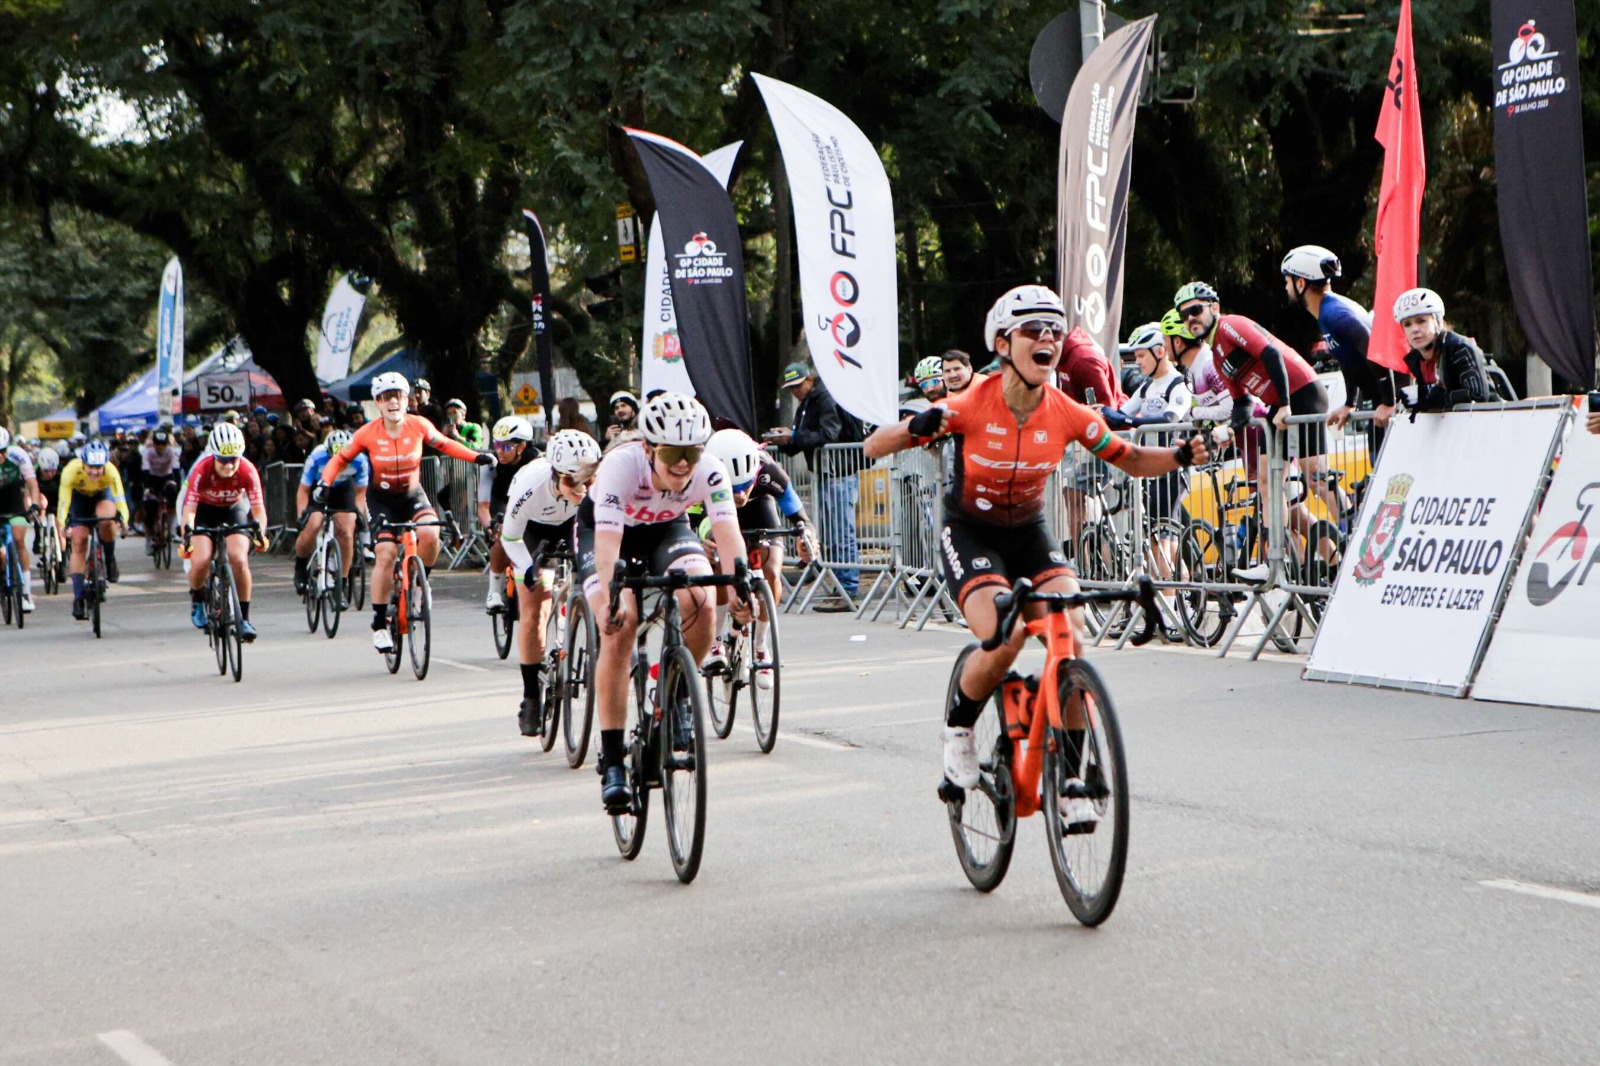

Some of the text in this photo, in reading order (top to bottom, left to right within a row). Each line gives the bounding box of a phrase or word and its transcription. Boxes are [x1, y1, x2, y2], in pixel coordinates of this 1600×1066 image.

[1501, 59, 1554, 87] GP CIDADE
[1495, 76, 1566, 108] DE SÃO PAULO
[1087, 82, 1101, 144] FEDERAÇÃO
[1094, 97, 1107, 146] PAULISTA
[1102, 85, 1115, 149] DE CICLISMO
[824, 145, 841, 185] PAULISTA
[1086, 144, 1109, 232] FPC
[826, 185, 857, 260] FPC
[675, 266, 734, 279] DE SÃO PAULO
[680, 256, 724, 268] GP CIDADE
[1222, 321, 1247, 347] COMPLEX
[674, 418, 694, 441] 17
[552, 446, 564, 463] 16
[510, 488, 533, 519] PENKS
[1410, 496, 1496, 527] CIDADE DE
[1392, 529, 1503, 576] SÃO PAULO
[1381, 585, 1484, 611] ESPORTES E LAZER
